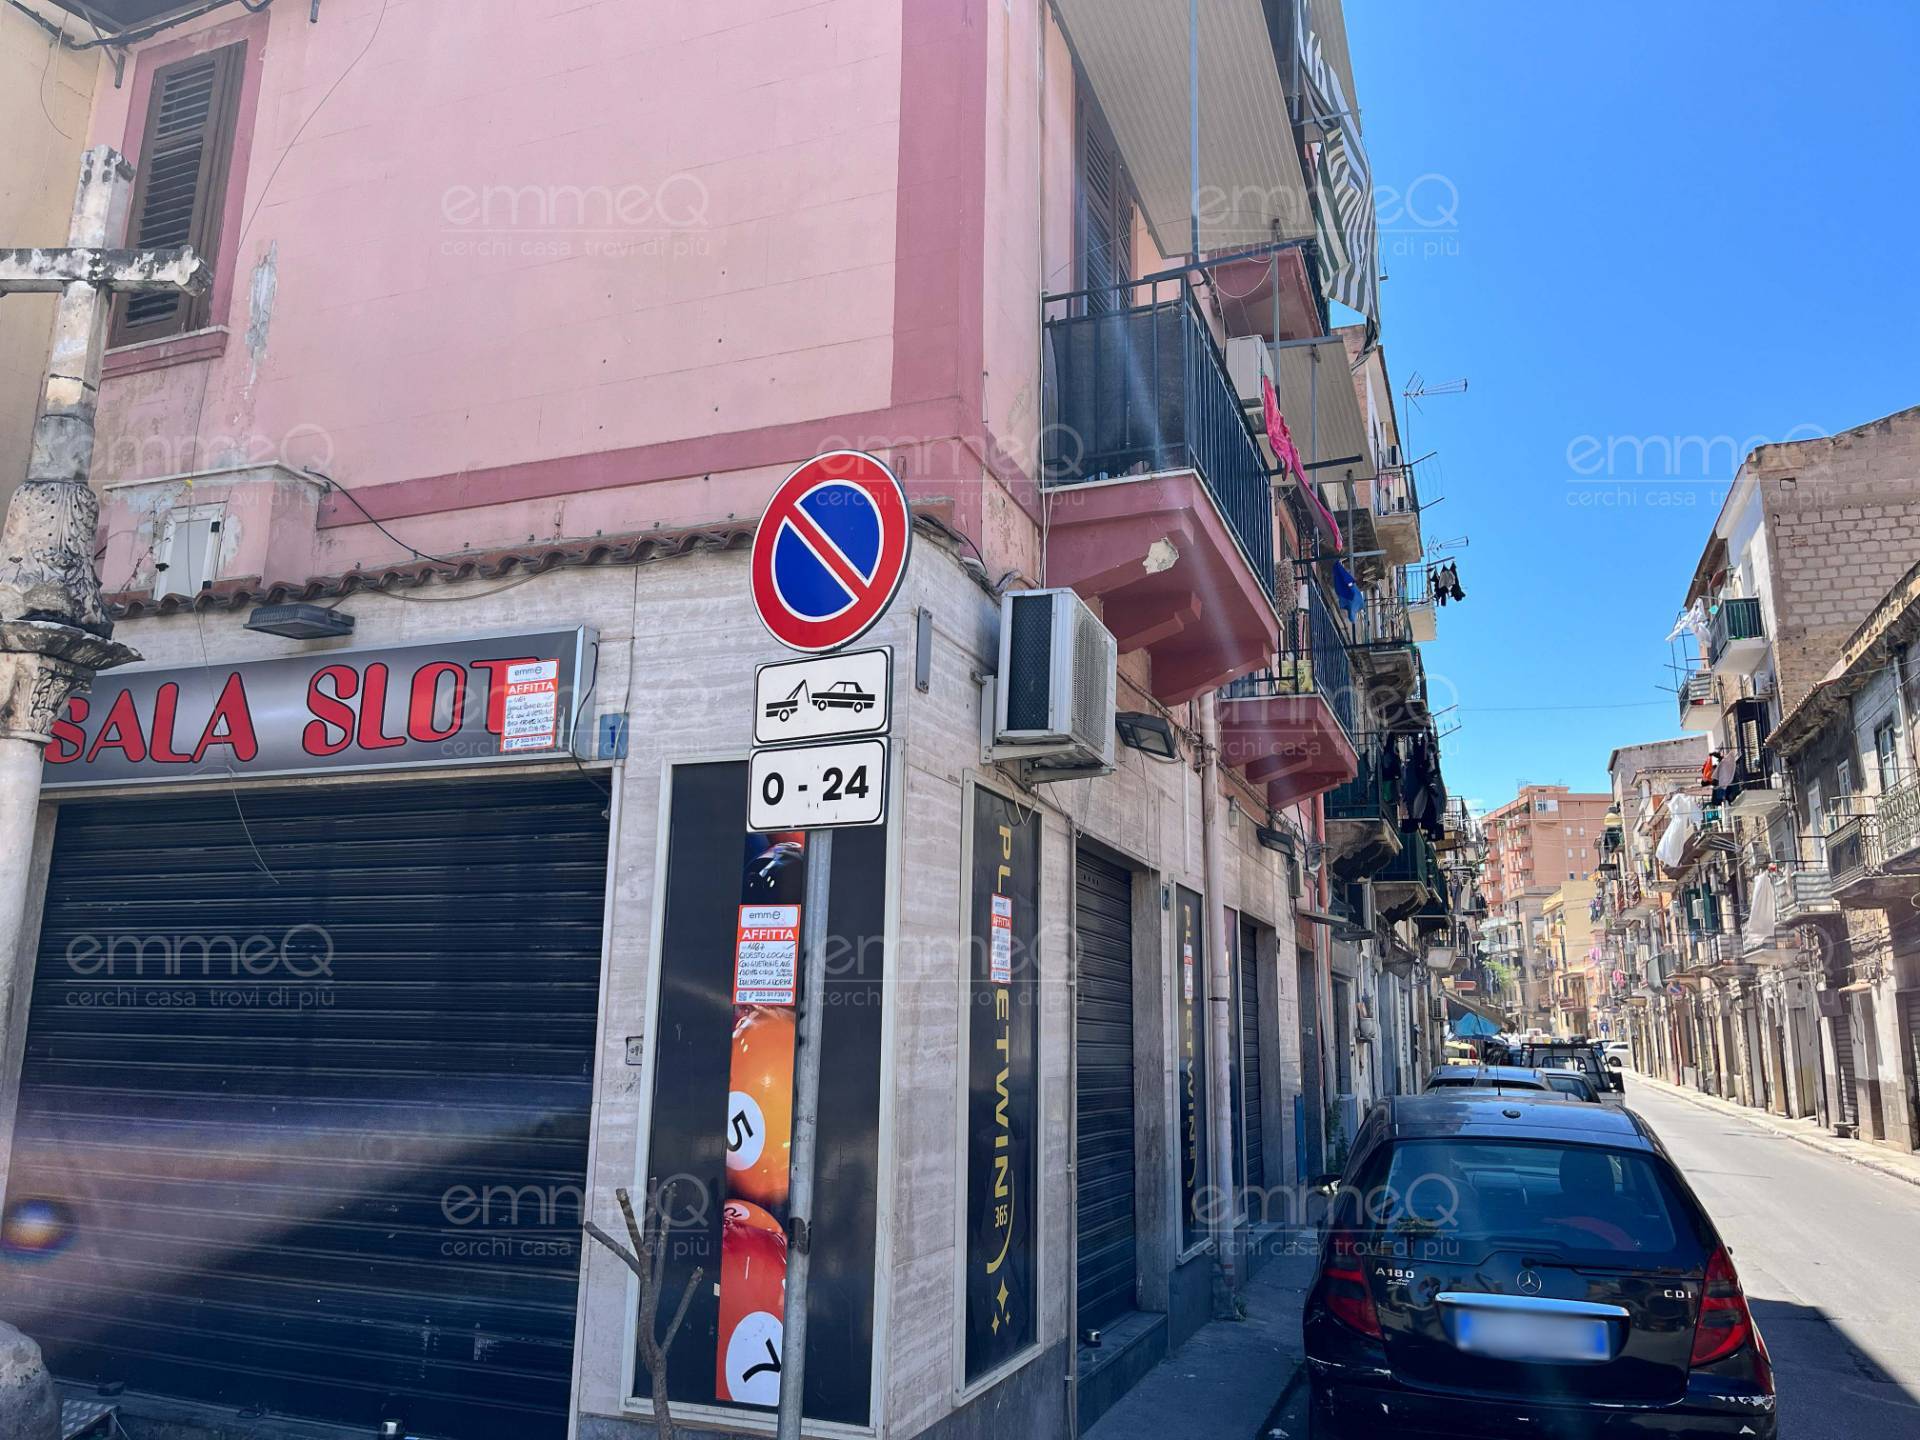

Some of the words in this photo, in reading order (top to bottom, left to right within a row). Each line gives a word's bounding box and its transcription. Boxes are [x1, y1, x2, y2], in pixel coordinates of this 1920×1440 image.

[508, 681, 555, 695] AFFITTA
[46, 671, 258, 763] SALA
[301, 656, 541, 756] SLOT
[762, 771, 784, 806] 0
[822, 765, 869, 801] 24
[742, 929, 794, 940] AFFITTA
[995, 825, 1011, 1198] PLETWIN
[727, 1110, 754, 1152] 5
[994, 1204, 1008, 1228] 365
[1375, 1267, 1415, 1279] A180
[1663, 1289, 1692, 1299] CDI
